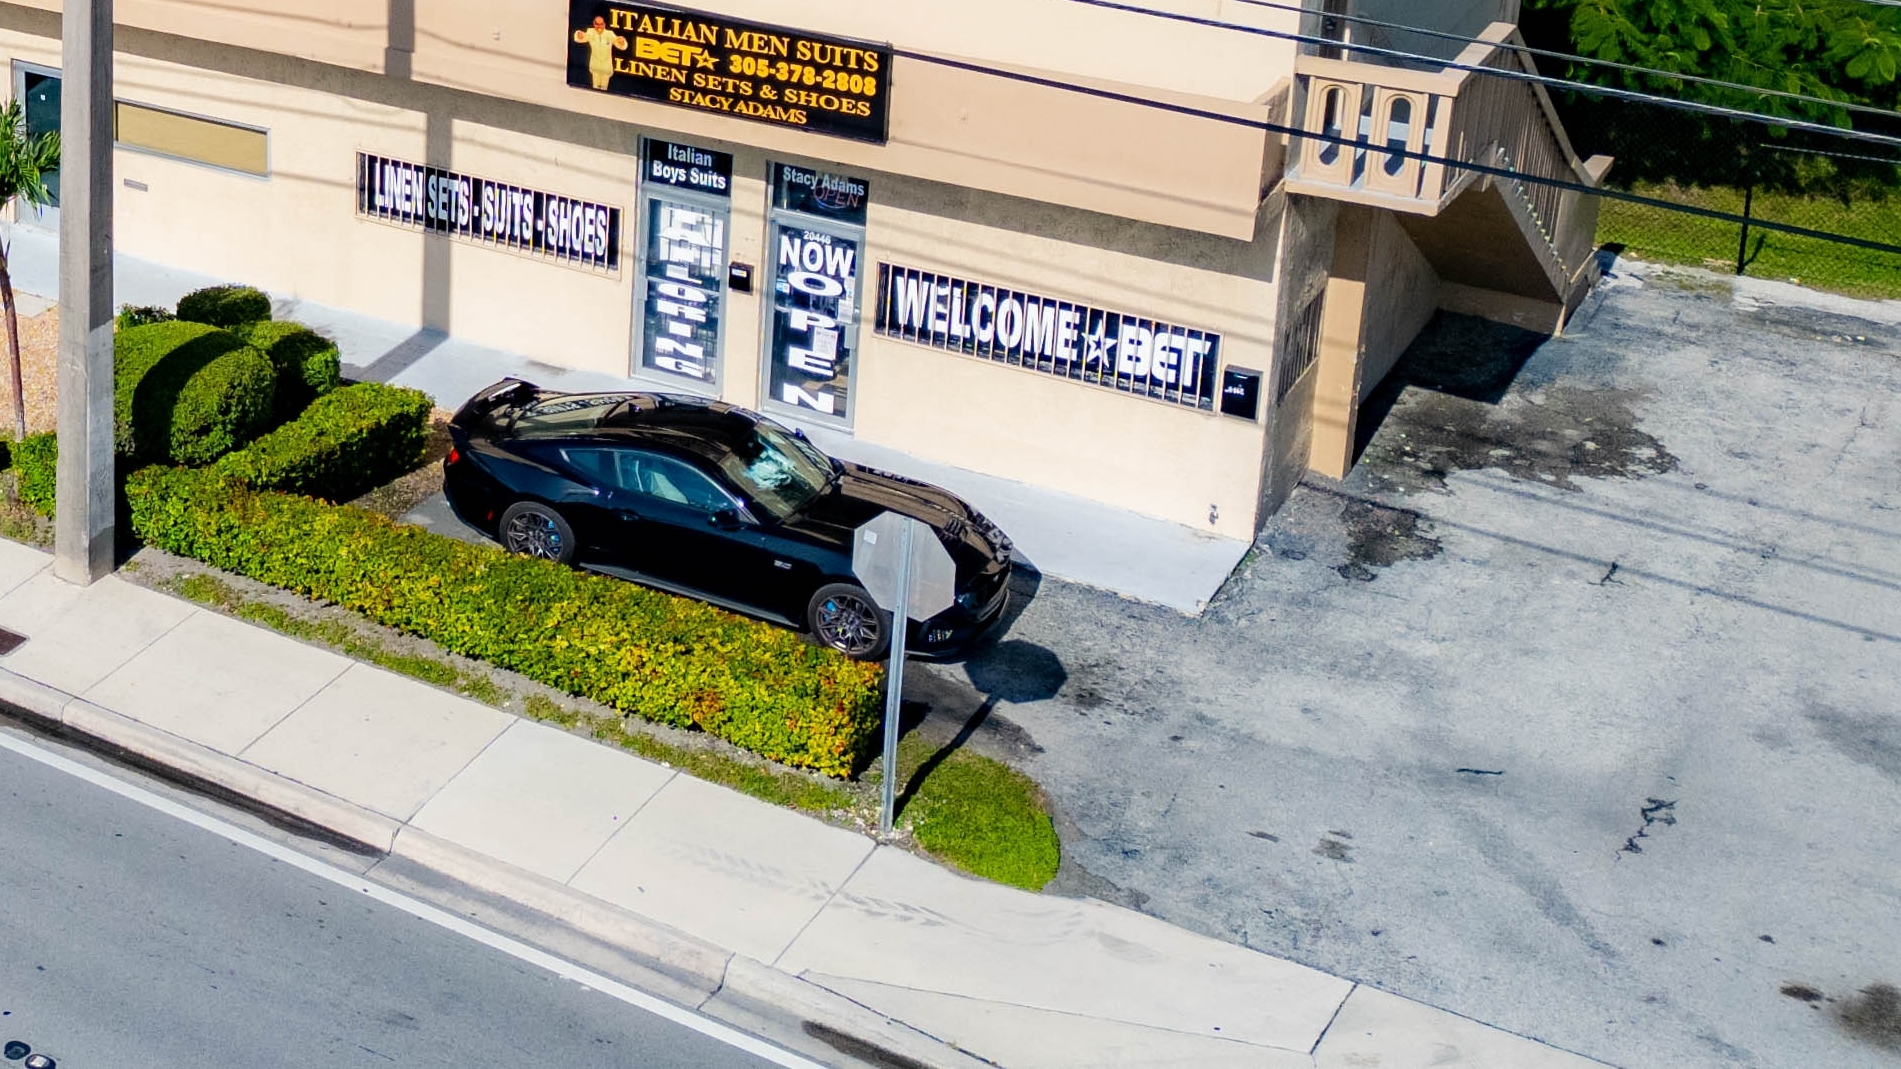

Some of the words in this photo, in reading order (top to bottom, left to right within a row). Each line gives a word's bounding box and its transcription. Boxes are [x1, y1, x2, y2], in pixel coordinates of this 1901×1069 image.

[609, 8, 717, 47] ITALIAN
[724, 29, 789, 57] MEN
[796, 40, 879, 72] SUITS
[614, 57, 687, 84] LINEN
[693, 73, 753, 97] SETS
[759, 85, 779, 100] &
[784, 89, 871, 117] SHOES
[635, 37, 702, 67] BET
[729, 54, 877, 97] 305-378-2808
[669, 87, 734, 112] STACY
[737, 100, 807, 125] ADAMS
[652, 160, 687, 183] Boys
[690, 166, 727, 190] Suits
[667, 143, 713, 167] Italian
[782, 166, 819, 189] Stacy
[821, 174, 865, 197] Adams
[813, 185, 860, 208] OPEN
[374, 161, 424, 216] LINEN
[427, 174, 471, 226] SETS
[484, 186, 533, 240] SUITS
[548, 199, 606, 256] SHOES
[779, 235, 855, 278] NOW
[783, 271, 843, 415] OPEN
[895, 275, 1080, 362] WELCOME
[1118, 323, 1211, 387] BET
